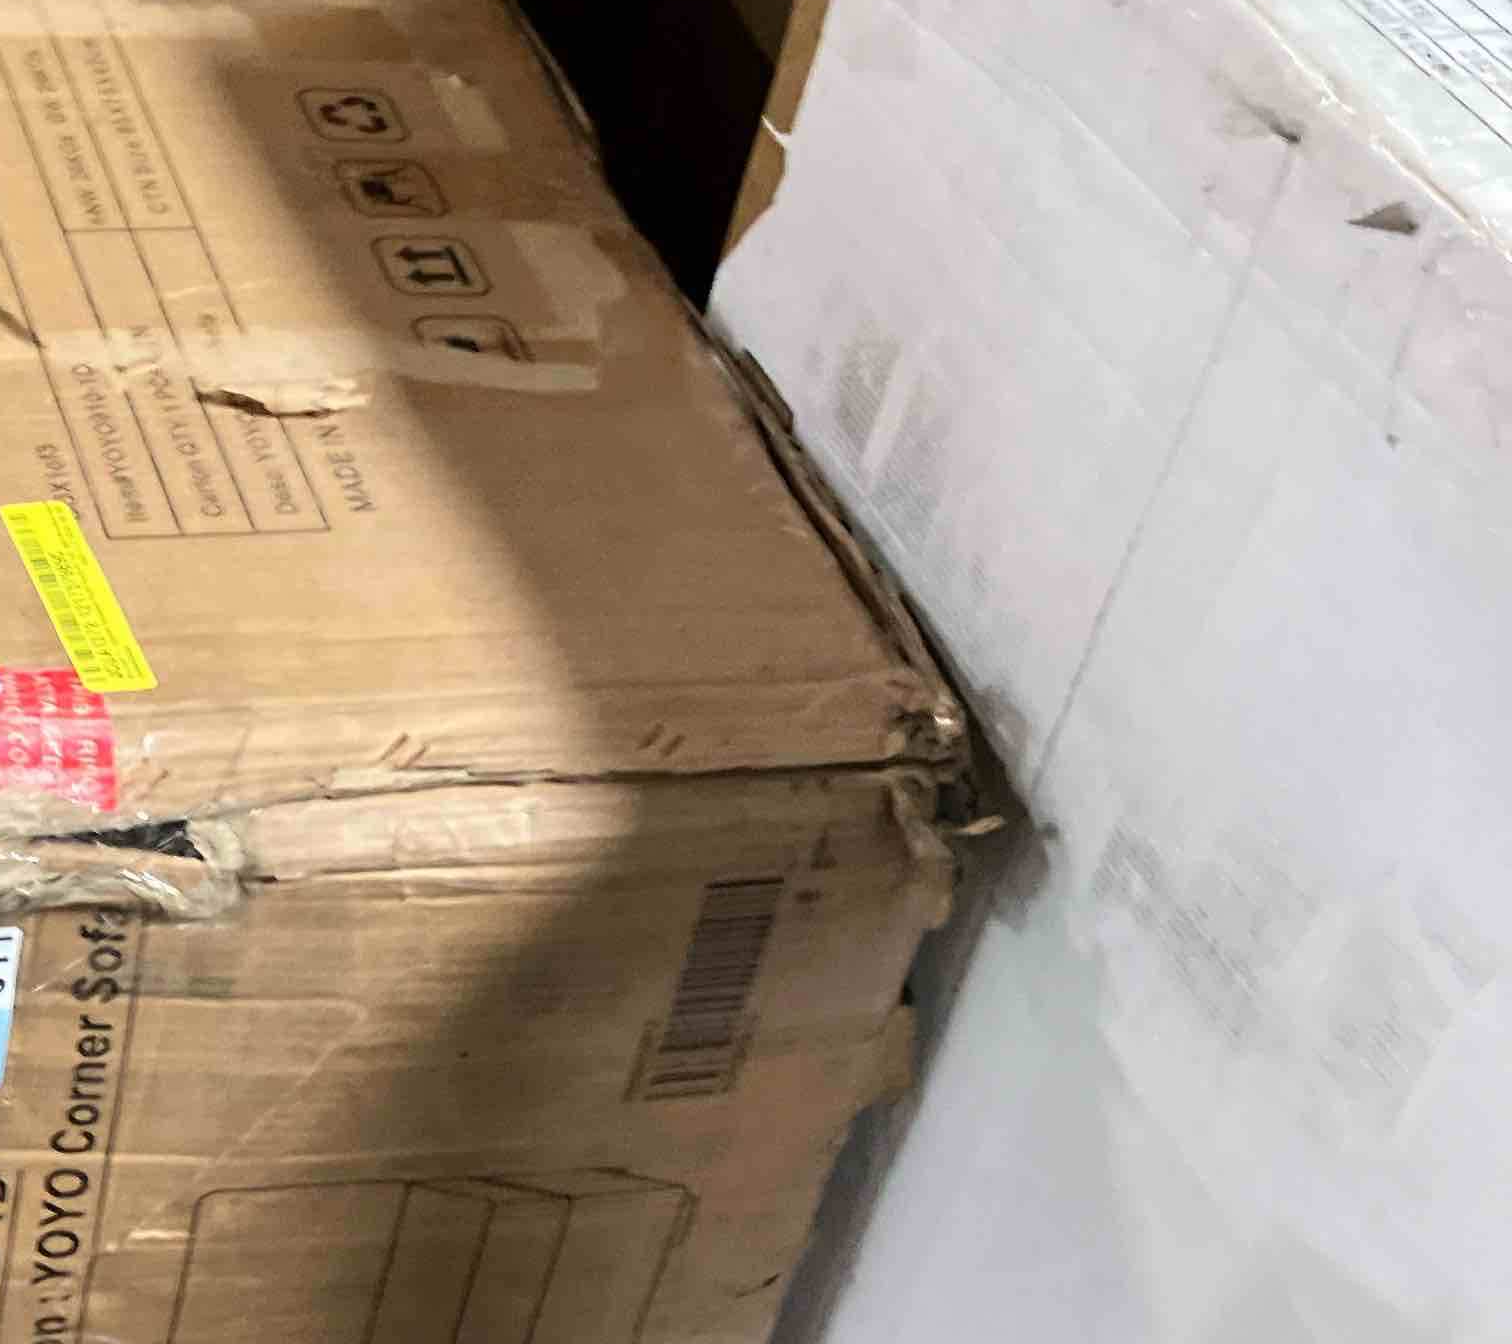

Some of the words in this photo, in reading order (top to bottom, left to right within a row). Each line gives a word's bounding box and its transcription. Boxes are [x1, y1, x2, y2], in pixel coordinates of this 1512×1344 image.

[326, 451, 377, 513] MADE
[49, 1013, 114, 1154] Corner
[33, 1168, 90, 1286] YOYO
